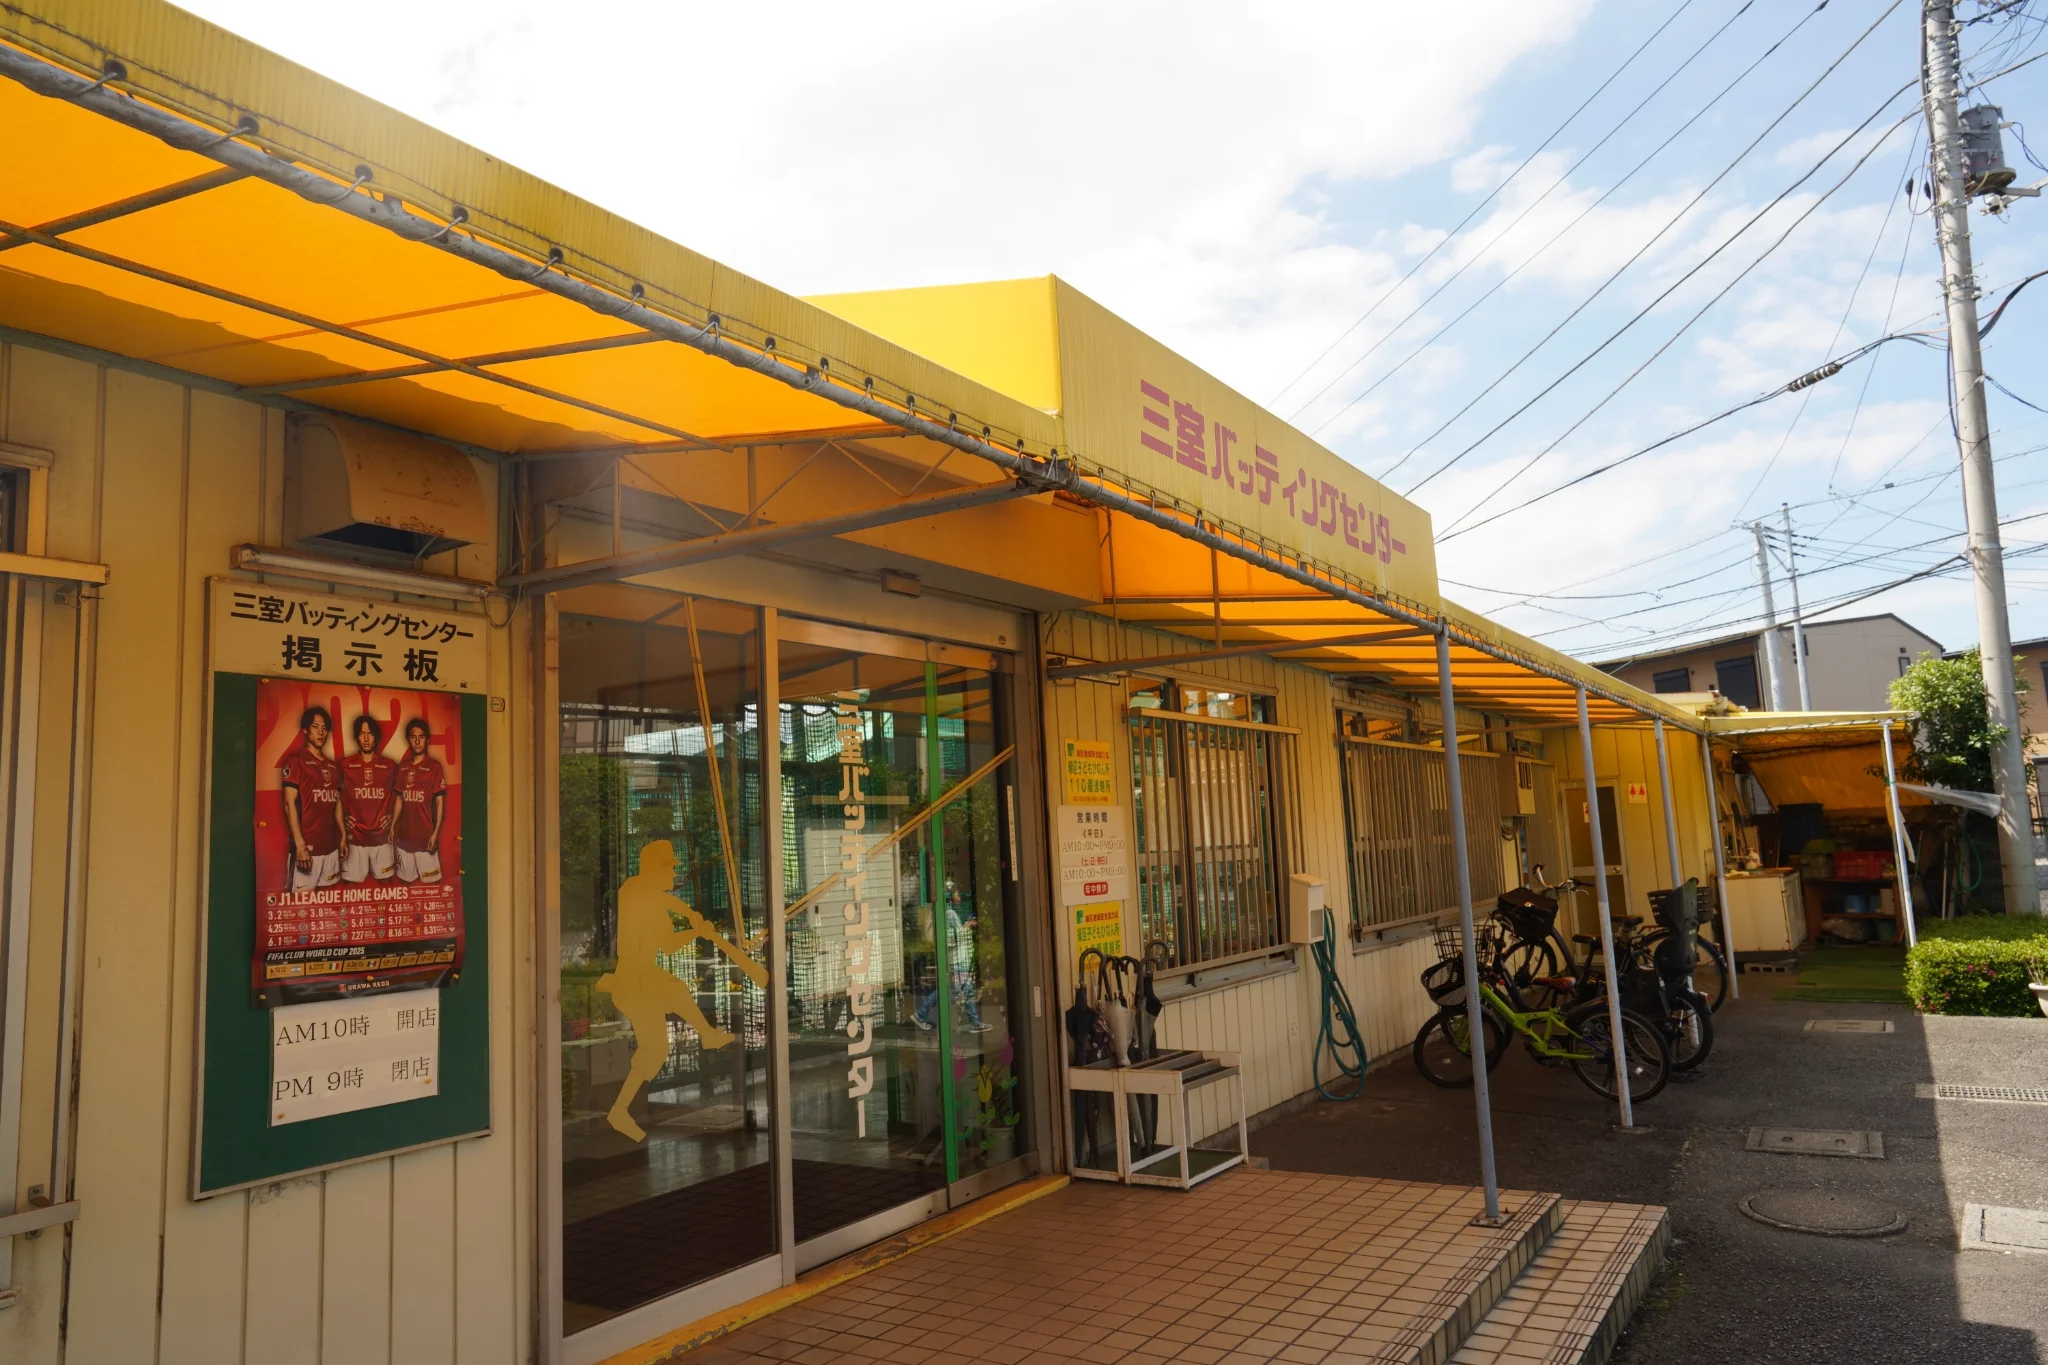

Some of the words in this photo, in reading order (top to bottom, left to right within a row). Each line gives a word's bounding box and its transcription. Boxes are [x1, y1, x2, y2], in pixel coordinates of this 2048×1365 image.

[1140, 379, 1406, 564] 三室バッティングセンター
[230, 592, 474, 643] 三室バッティングセンター
[282, 635, 439, 683] 掲示板
[354, 788, 384, 800] POLUS
[343, 888, 371, 902] HOME
[373, 887, 408, 900] GAMES
[267, 910, 283, 920] 3.2
[350, 906, 363, 915] 4.2
[837, 690, 874, 1138] 三室バッティングセンター
[311, 921, 325, 931] 5.3
[388, 915, 402, 925] 5.17
[268, 923, 283, 933] 4.25
[268, 937, 282, 947] 6.1
[267, 951, 284, 961] FIFA
[284, 950, 305, 959] CLUB
[305, 949, 332, 958] WORLD
[333, 948, 349, 956] CUP
[349, 947, 365, 955] 2025
[275, 1014, 370, 1046] AM10時
[397, 1007, 437, 1031] 開店
[274, 1075, 314, 1101] PM
[327, 1067, 364, 1091] 9時
[391, 1057, 430, 1082] 閉店
